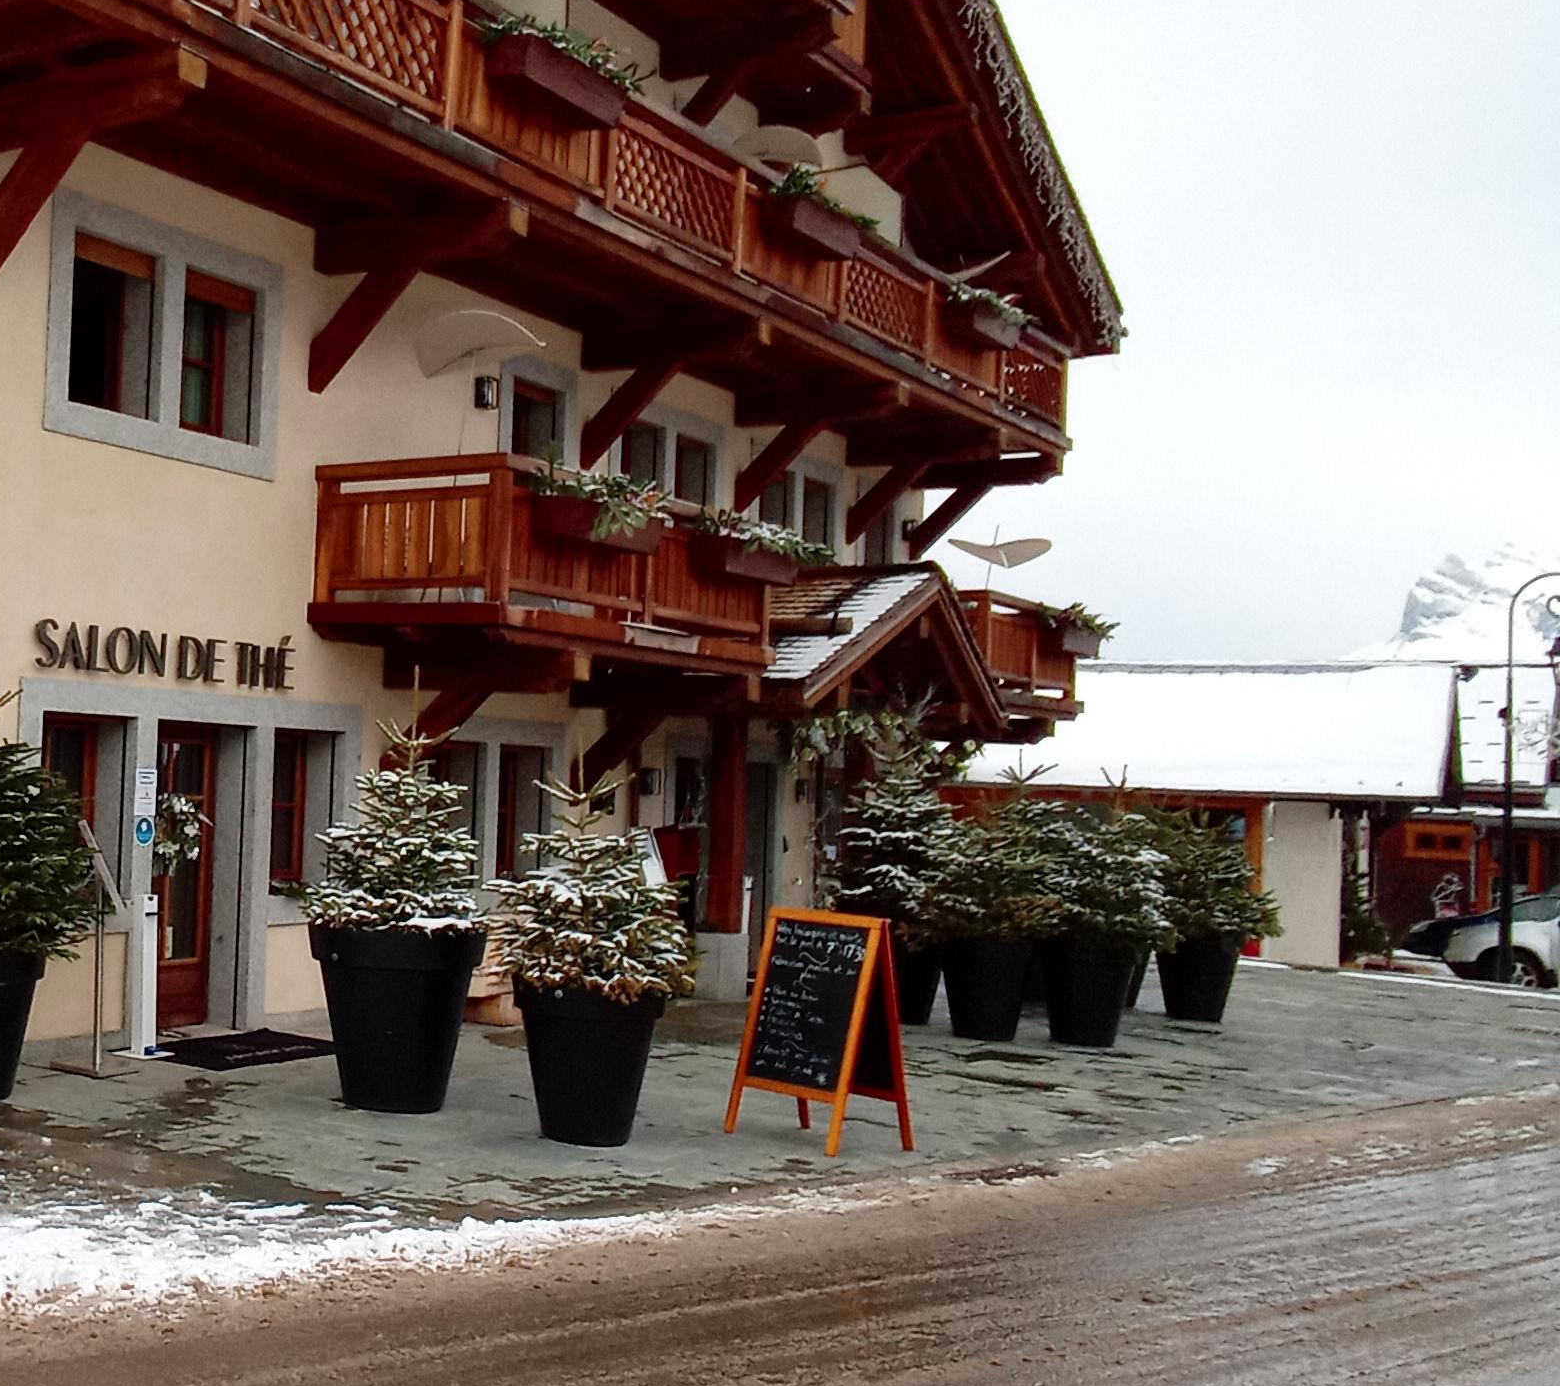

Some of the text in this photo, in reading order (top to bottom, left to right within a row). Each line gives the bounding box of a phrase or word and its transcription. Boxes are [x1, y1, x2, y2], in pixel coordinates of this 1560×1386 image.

[34, 618, 296, 691] SALON DE THÉ
